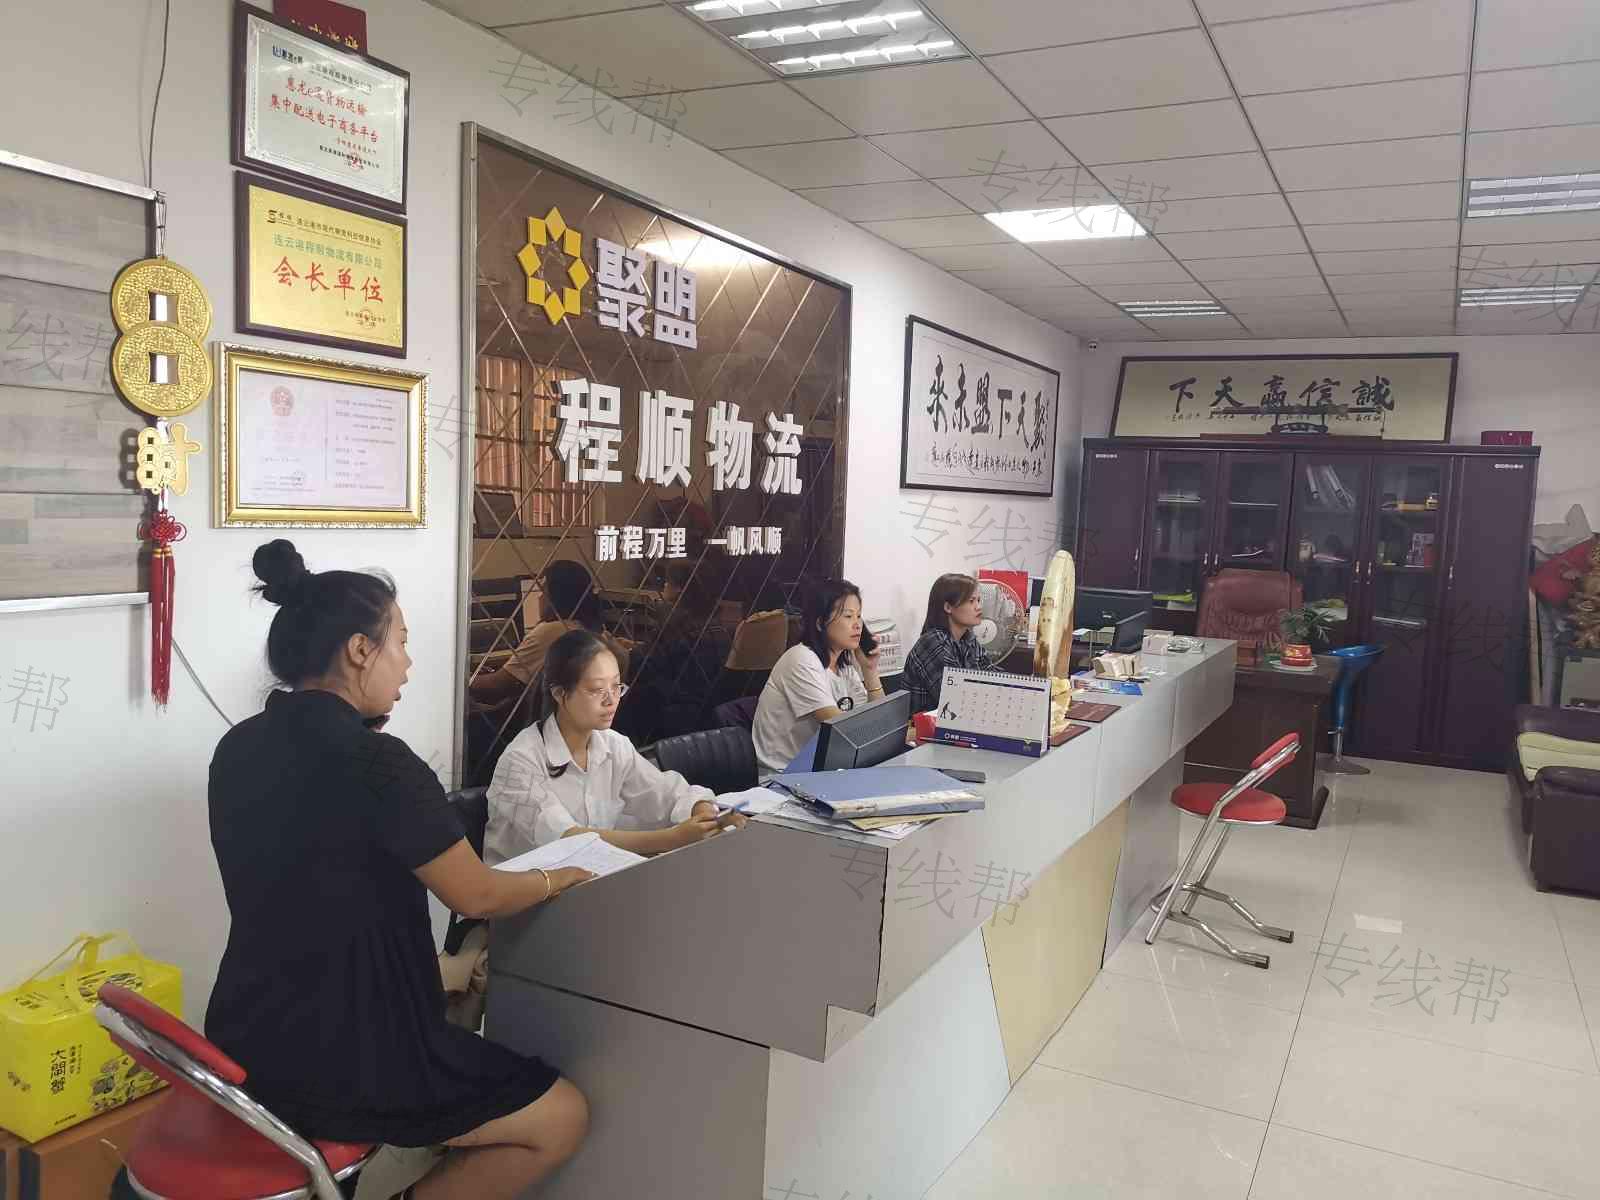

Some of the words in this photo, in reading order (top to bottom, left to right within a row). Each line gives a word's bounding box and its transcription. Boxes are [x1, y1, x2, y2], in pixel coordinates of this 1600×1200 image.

[272, 255, 384, 303] 会长单位
[596, 238, 698, 349] 聚盟
[552, 377, 804, 495] 程顺物流
[594, 525, 688, 561] 前程万里
[704, 525, 783, 555] 一帆风顺
